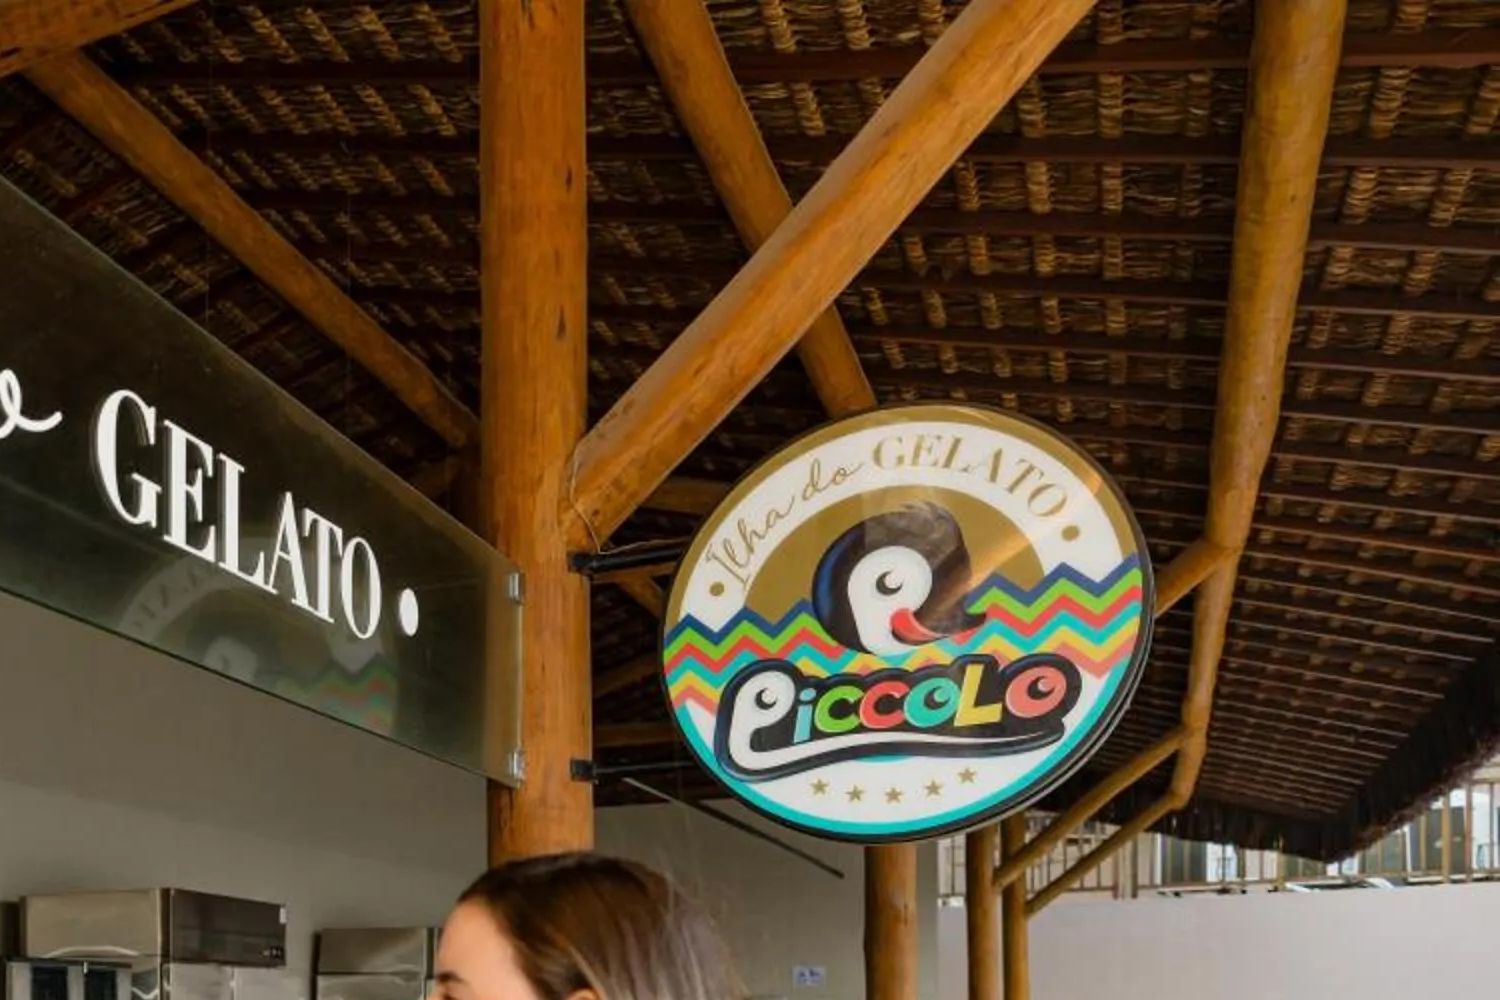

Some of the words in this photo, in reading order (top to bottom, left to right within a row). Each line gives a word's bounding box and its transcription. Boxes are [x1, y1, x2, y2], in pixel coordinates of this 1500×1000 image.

[96, 389, 383, 640] GELATO
[704, 494, 796, 588] Ilha
[801, 457, 864, 502] do
[871, 433, 1069, 519] GELATO
